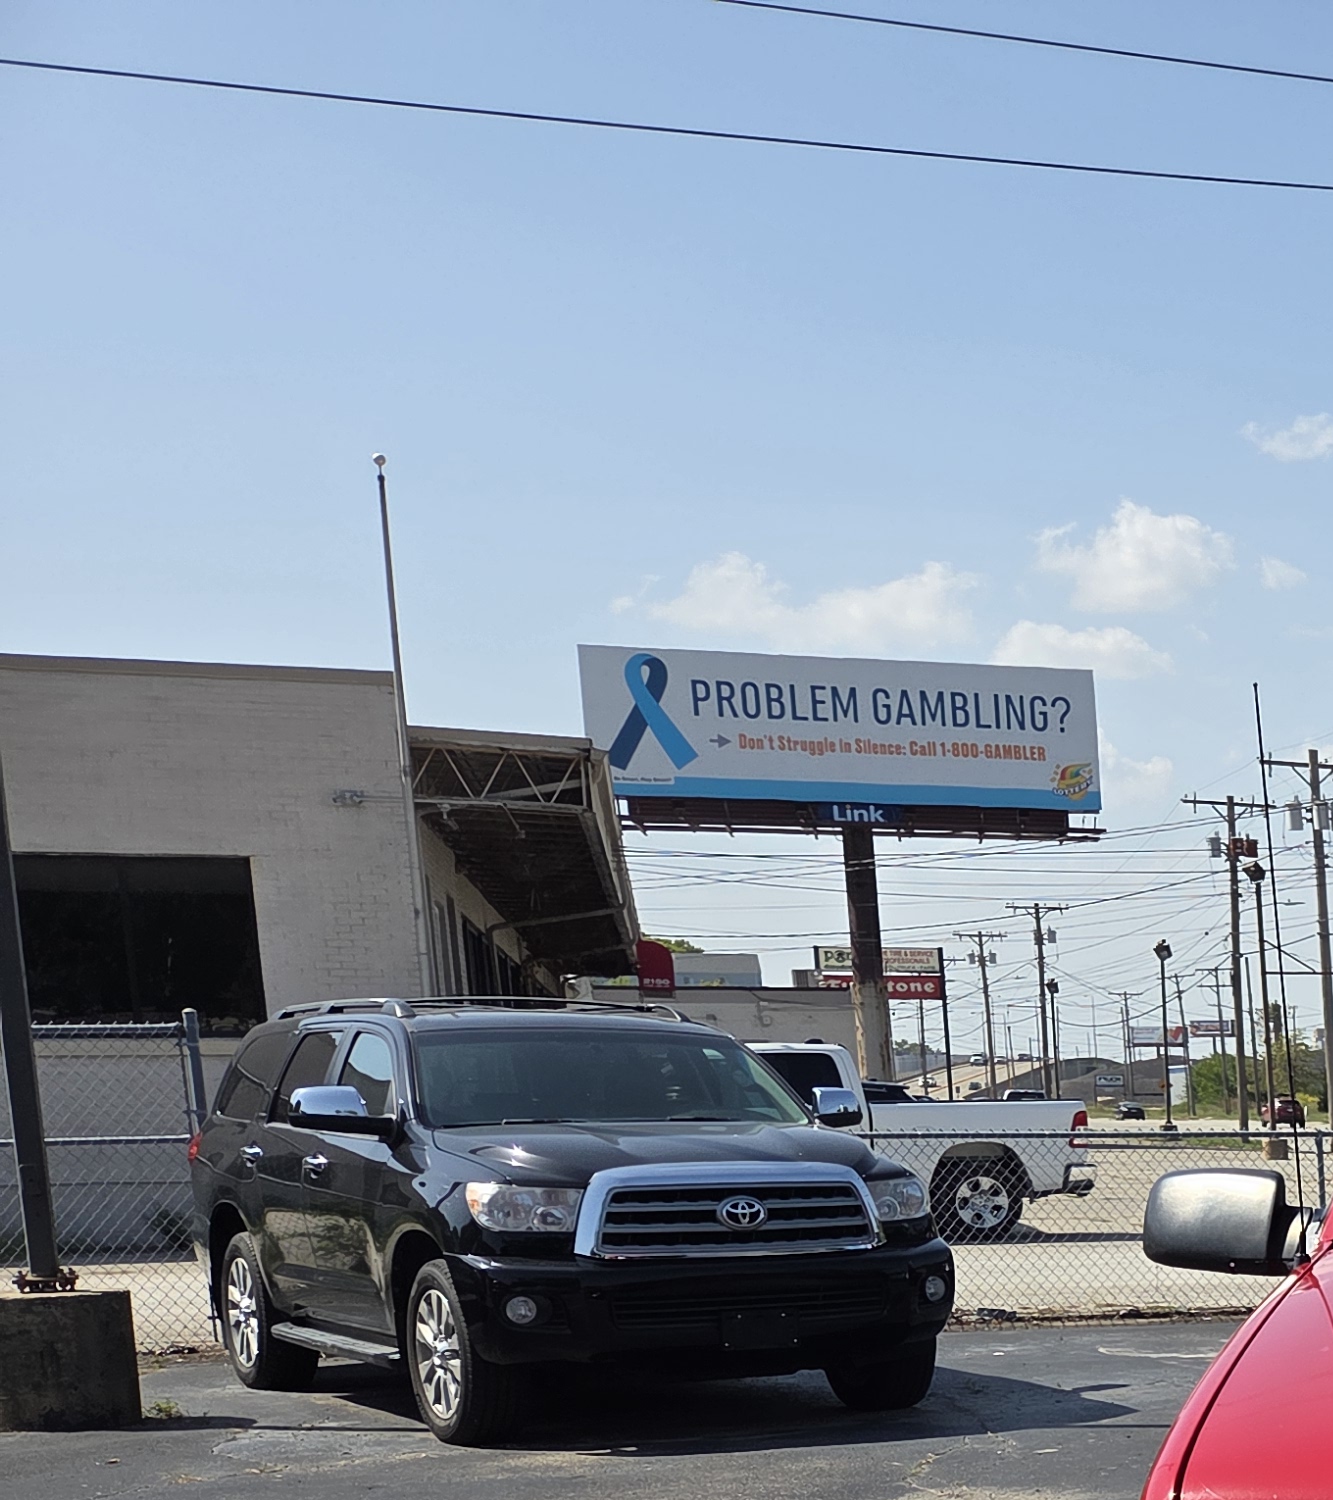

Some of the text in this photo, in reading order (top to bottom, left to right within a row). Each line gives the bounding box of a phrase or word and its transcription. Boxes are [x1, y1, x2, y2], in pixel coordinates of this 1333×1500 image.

[690, 679, 1072, 734] PROBLEM GAMBLING?
[738, 733, 776, 750] Don't
[778, 735, 836, 756] Struggle
[854, 738, 908, 756] Silence:
[909, 740, 937, 757] Call
[939, 742, 1047, 762] 1-800-GAMBLER
[832, 804, 885, 823] Link
